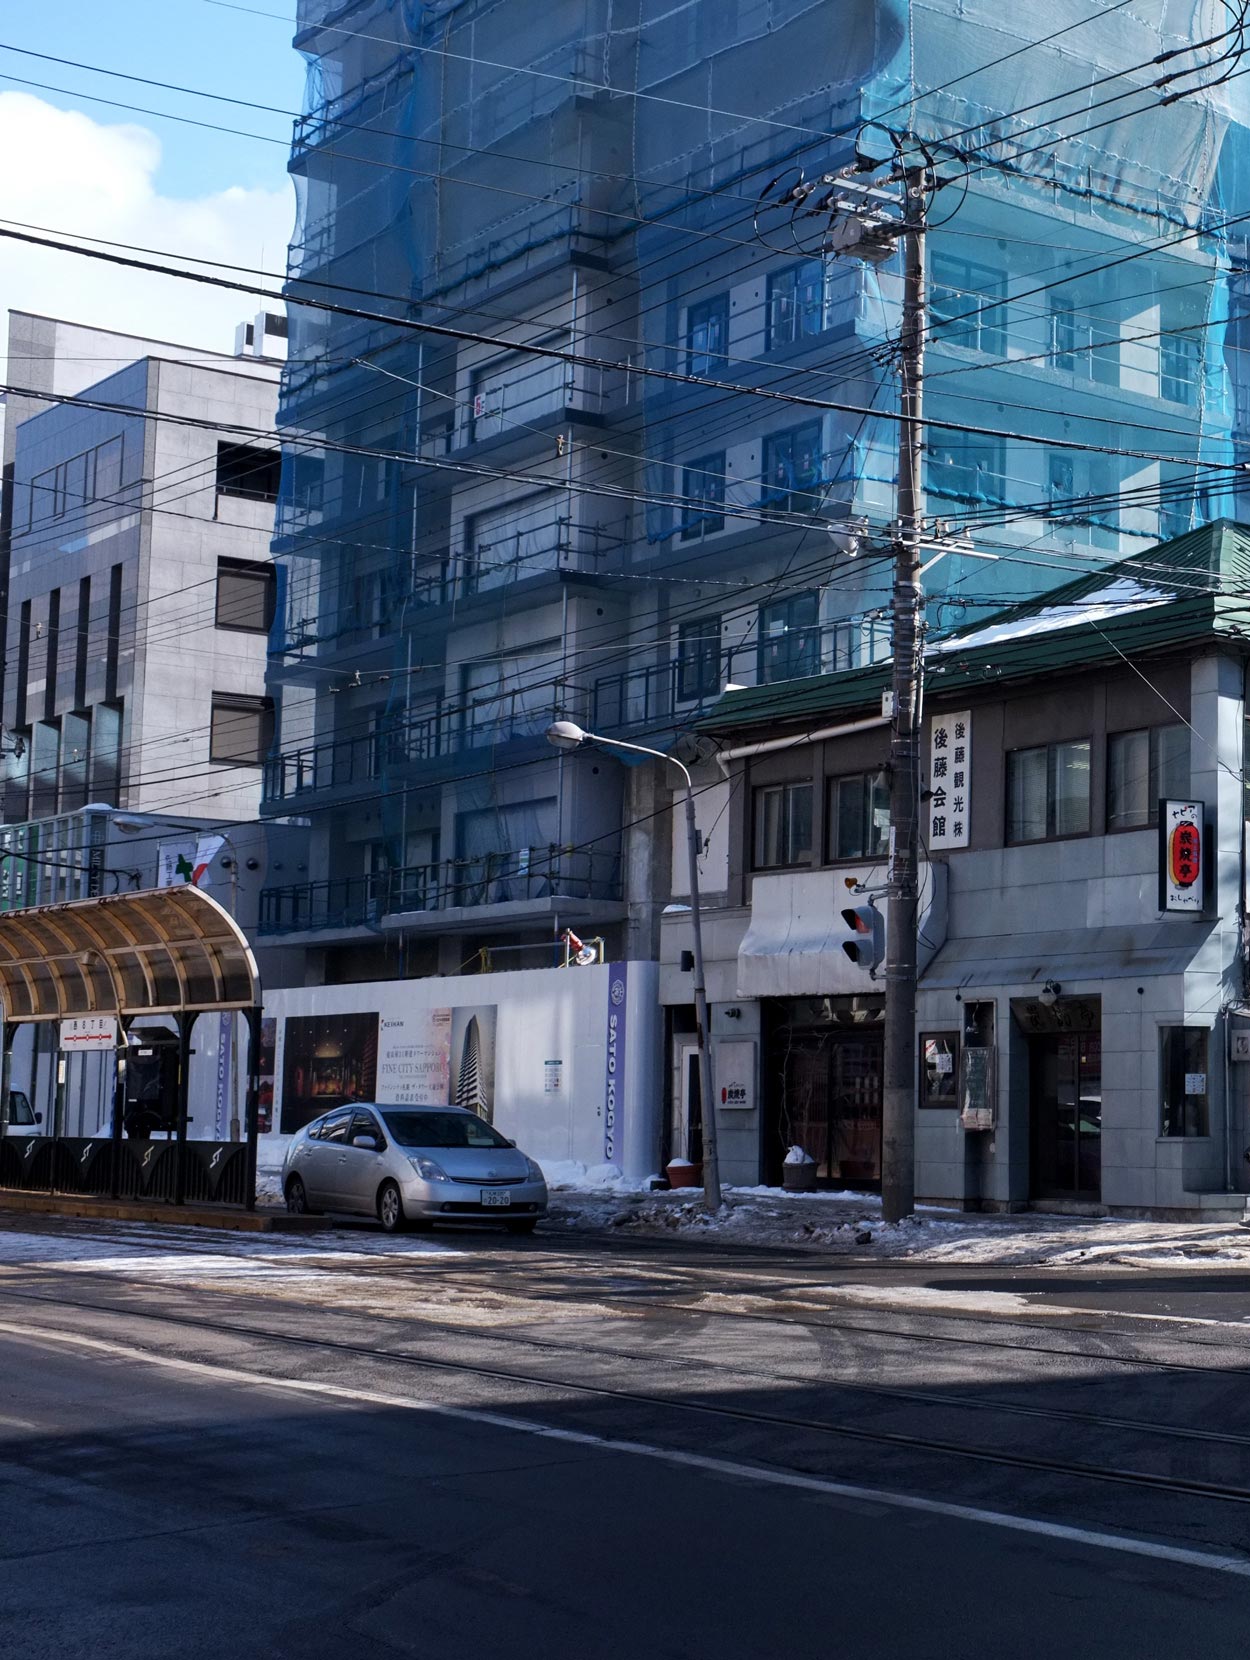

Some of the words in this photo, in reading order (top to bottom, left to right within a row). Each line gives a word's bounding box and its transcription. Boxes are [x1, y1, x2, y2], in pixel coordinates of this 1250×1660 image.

[932, 728, 948, 837] 後藤会館
[953, 722, 965, 837] 後藤観光株
[382, 1063, 397, 1074] FINE
[398, 1063, 413, 1074] CITY
[608, 1014, 618, 1075] SATO
[605, 1079, 617, 1160] KOGYO
